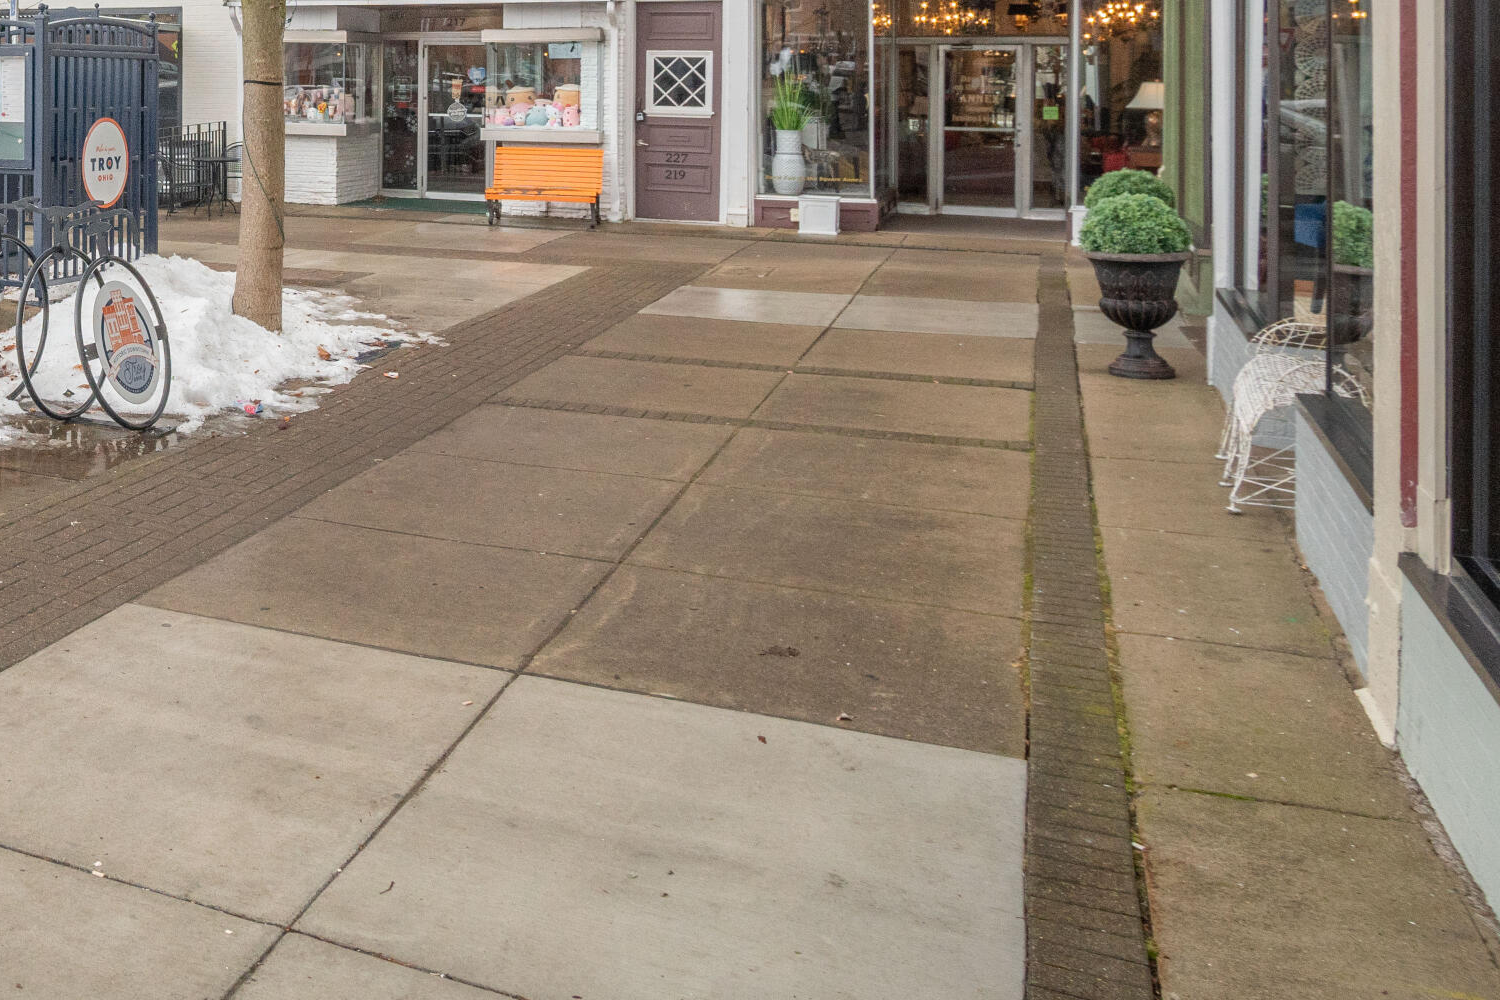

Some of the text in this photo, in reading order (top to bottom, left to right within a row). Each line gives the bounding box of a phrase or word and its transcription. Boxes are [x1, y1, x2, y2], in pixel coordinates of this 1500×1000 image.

[665, 153, 689, 163] 227
[90, 155, 121, 172] TROY
[97, 173, 114, 182] OHIO
[665, 169, 686, 180] 219
